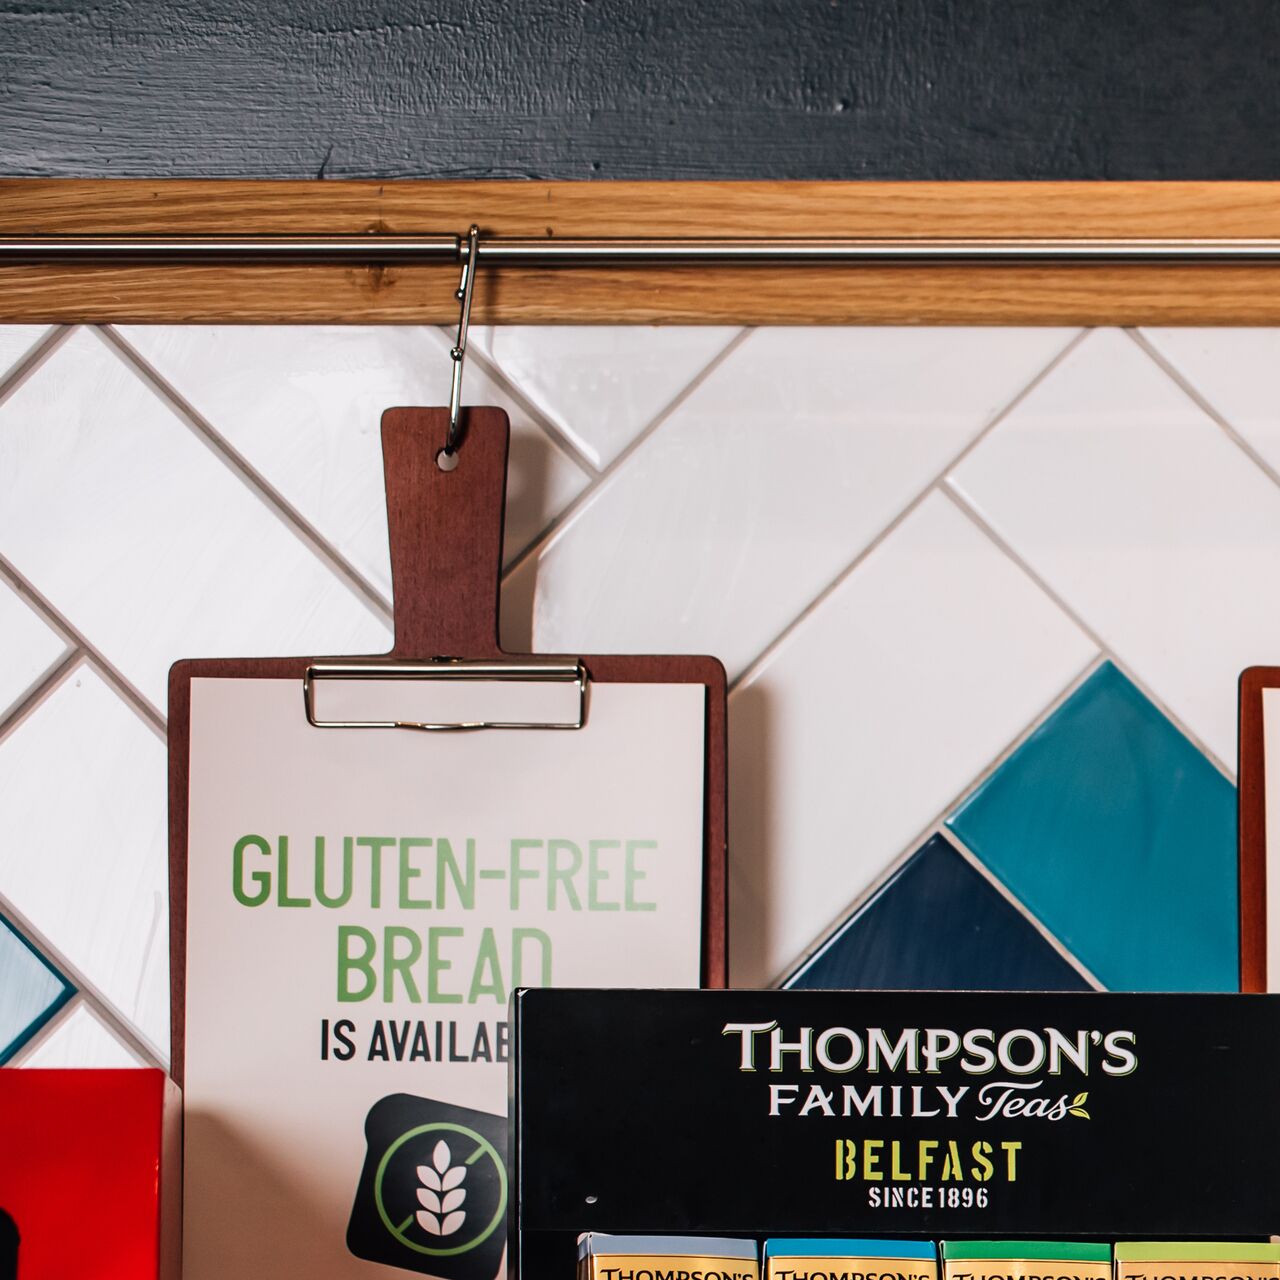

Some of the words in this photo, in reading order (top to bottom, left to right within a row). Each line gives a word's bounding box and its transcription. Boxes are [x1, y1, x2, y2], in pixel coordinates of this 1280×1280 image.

[231, 834, 659, 912] GLUTEN-FREE
[336, 925, 554, 1004] BREAD
[320, 1019, 357, 1061] IS
[368, 1021, 511, 1063] AVAILAB
[721, 1020, 1138, 1076] THOMPSON'S
[768, 1084, 970, 1118] FAMILY
[975, 1080, 1076, 1121] Teas
[835, 1139, 1023, 1183] BELFAST
[868, 1187, 934, 1209] SINCE
[938, 1187, 989, 1209] 1896
